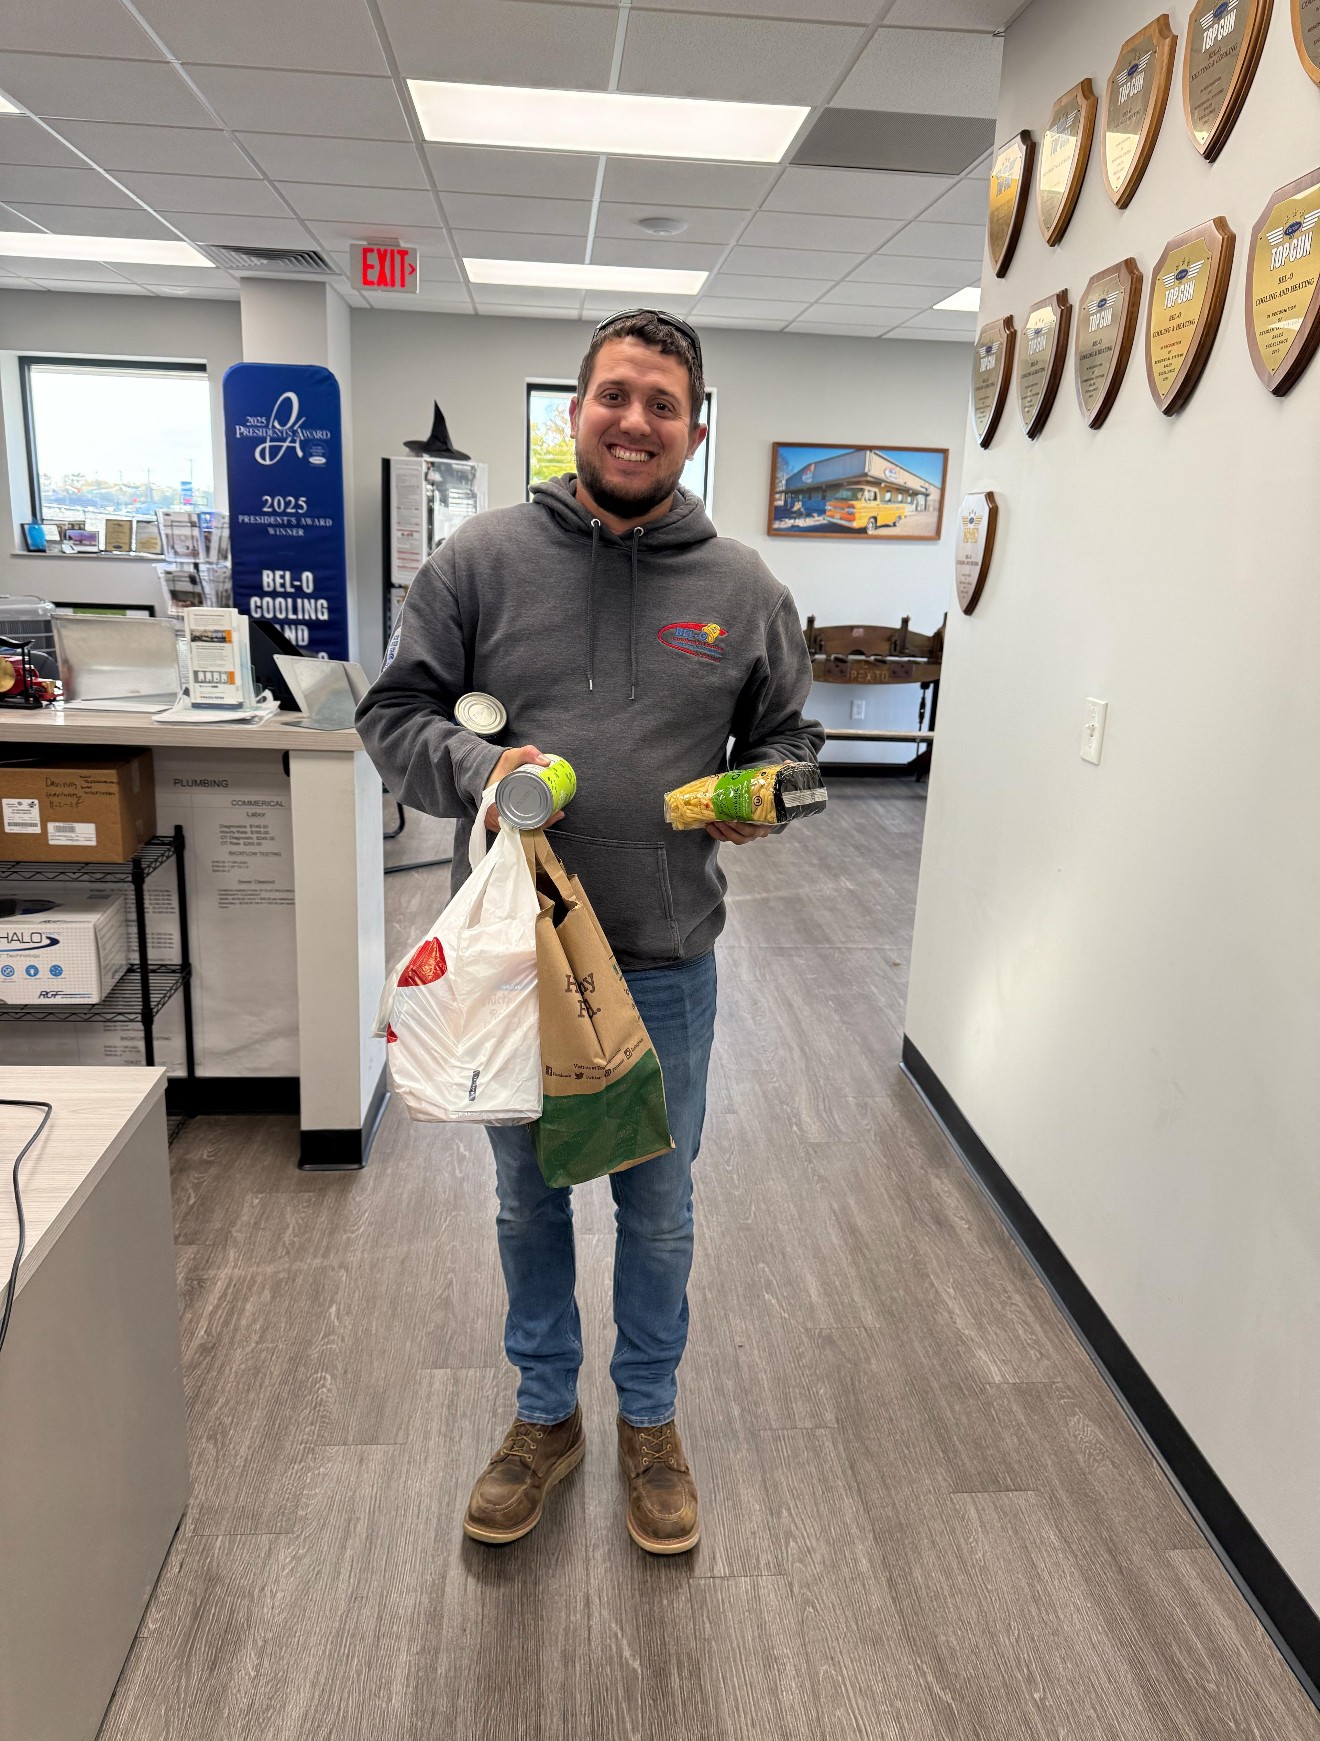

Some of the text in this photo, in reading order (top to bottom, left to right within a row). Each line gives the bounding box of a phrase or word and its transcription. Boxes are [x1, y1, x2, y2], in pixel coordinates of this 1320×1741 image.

[1202, 9, 1237, 53] TOP GUN
[1270, 231, 1313, 271] TOP GUN
[362, 248, 408, 288] EXIT
[1164, 280, 1195, 310] TOP GUN
[1255, 278, 1314, 306] COOLING AND HEATING
[246, 416, 267, 426] 2025
[294, 428, 331, 440] AWARD
[262, 495, 307, 513] 2025
[238, 514, 333, 526] PRESIDENT'S AWARD
[266, 526, 305, 537] WINNER
[262, 569, 314, 593] BEL-O
[250, 596, 329, 620] COOLING
[274, 624, 309, 646] ND
[173, 778, 229, 788] PLUMBING
[231, 800, 285, 808] COMMERICAL
[0, 932, 42, 944] HALO
[38, 990, 64, 999] RGF
